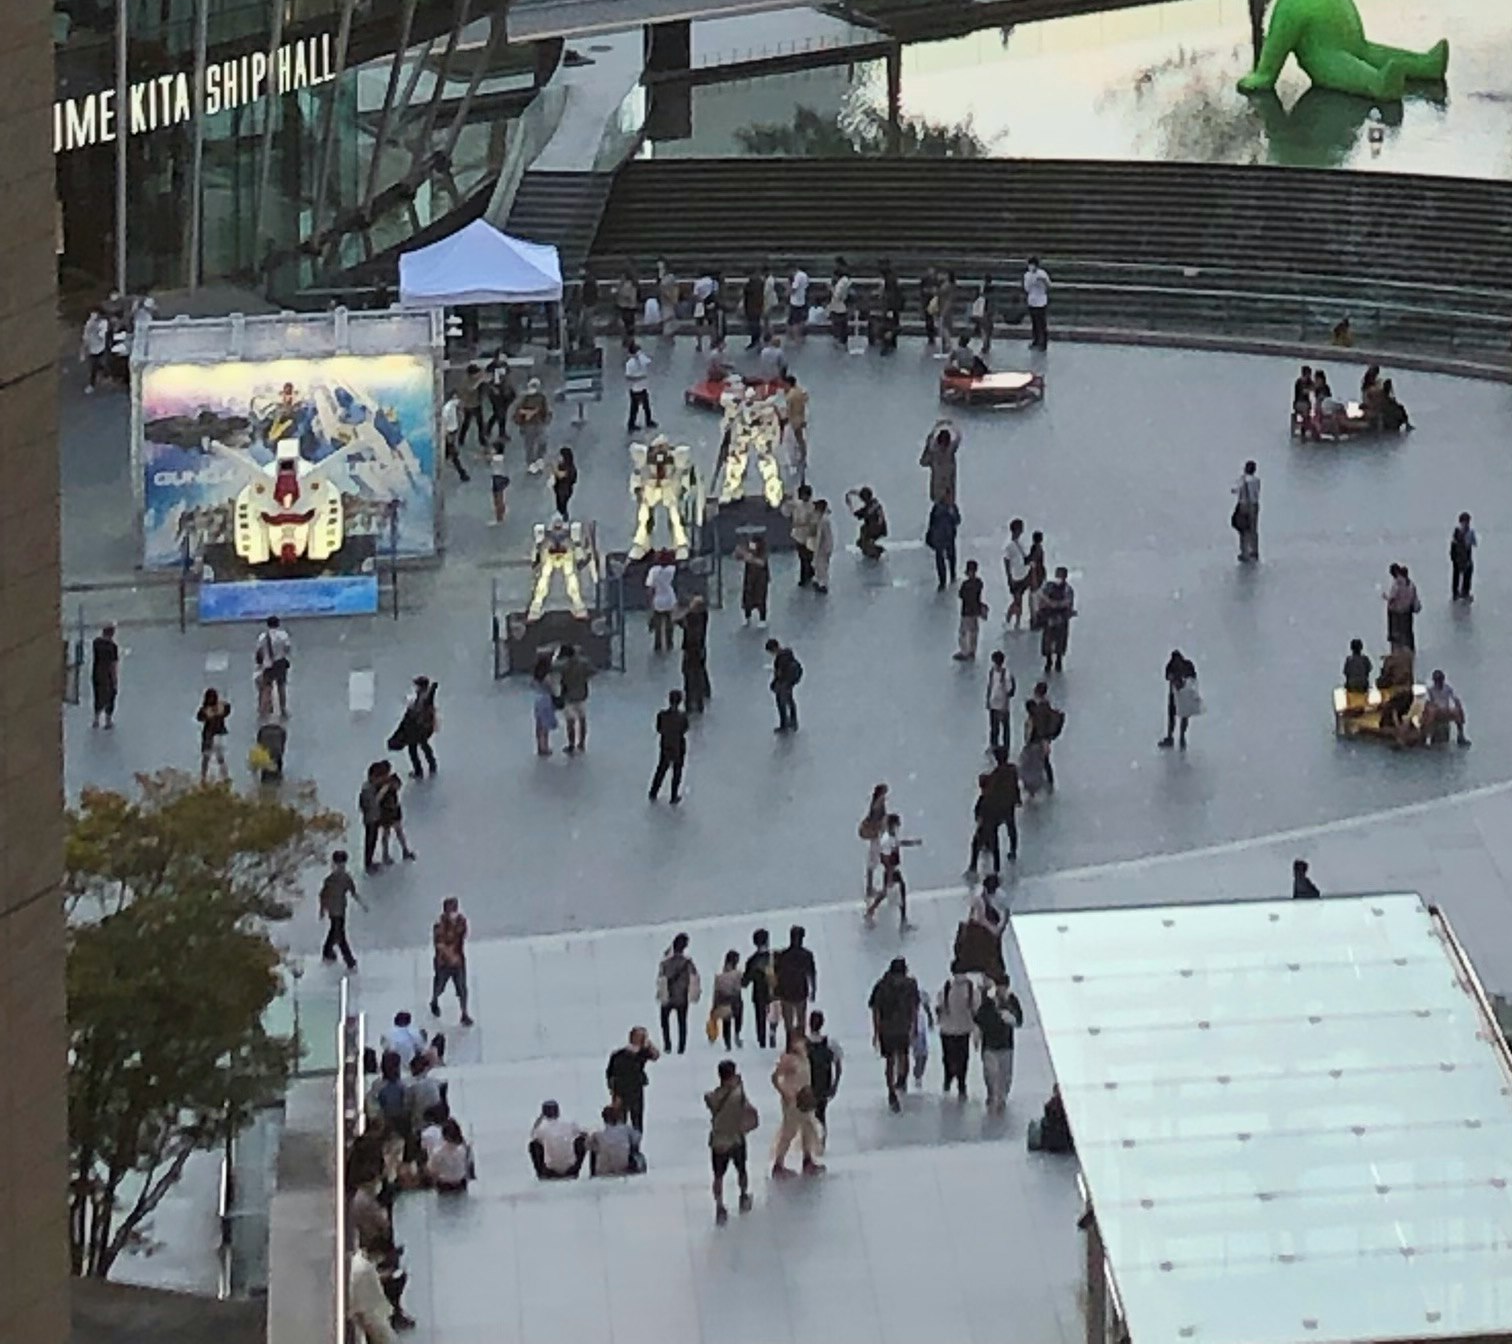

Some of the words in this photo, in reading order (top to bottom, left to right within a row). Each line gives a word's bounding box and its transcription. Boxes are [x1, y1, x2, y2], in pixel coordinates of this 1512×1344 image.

[205, 51, 266, 115] SHIP
[277, 33, 336, 95] HALL
[153, 469, 236, 486] GUNDA
